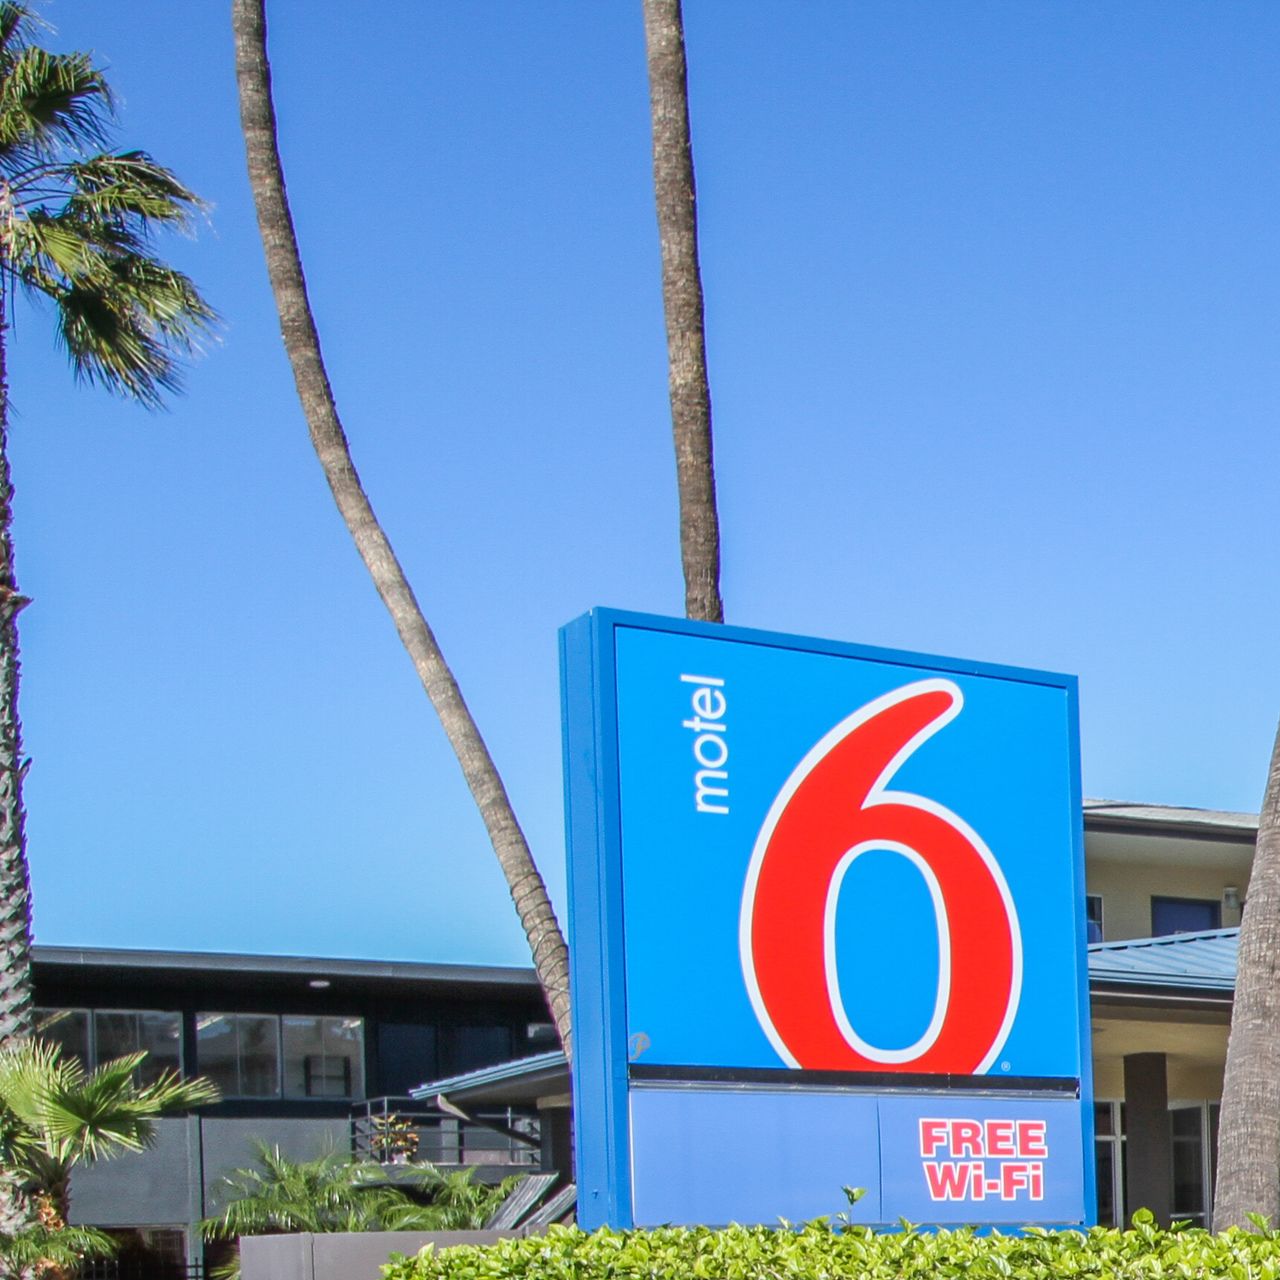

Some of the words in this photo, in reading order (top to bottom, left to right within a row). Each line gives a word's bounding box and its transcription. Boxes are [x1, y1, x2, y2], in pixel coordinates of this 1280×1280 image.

[680, 674, 729, 815] motel
[739, 678, 1023, 1076] 6
[919, 1118, 1048, 1159] FREE
[923, 1161, 1044, 1201] Wi-Fi
